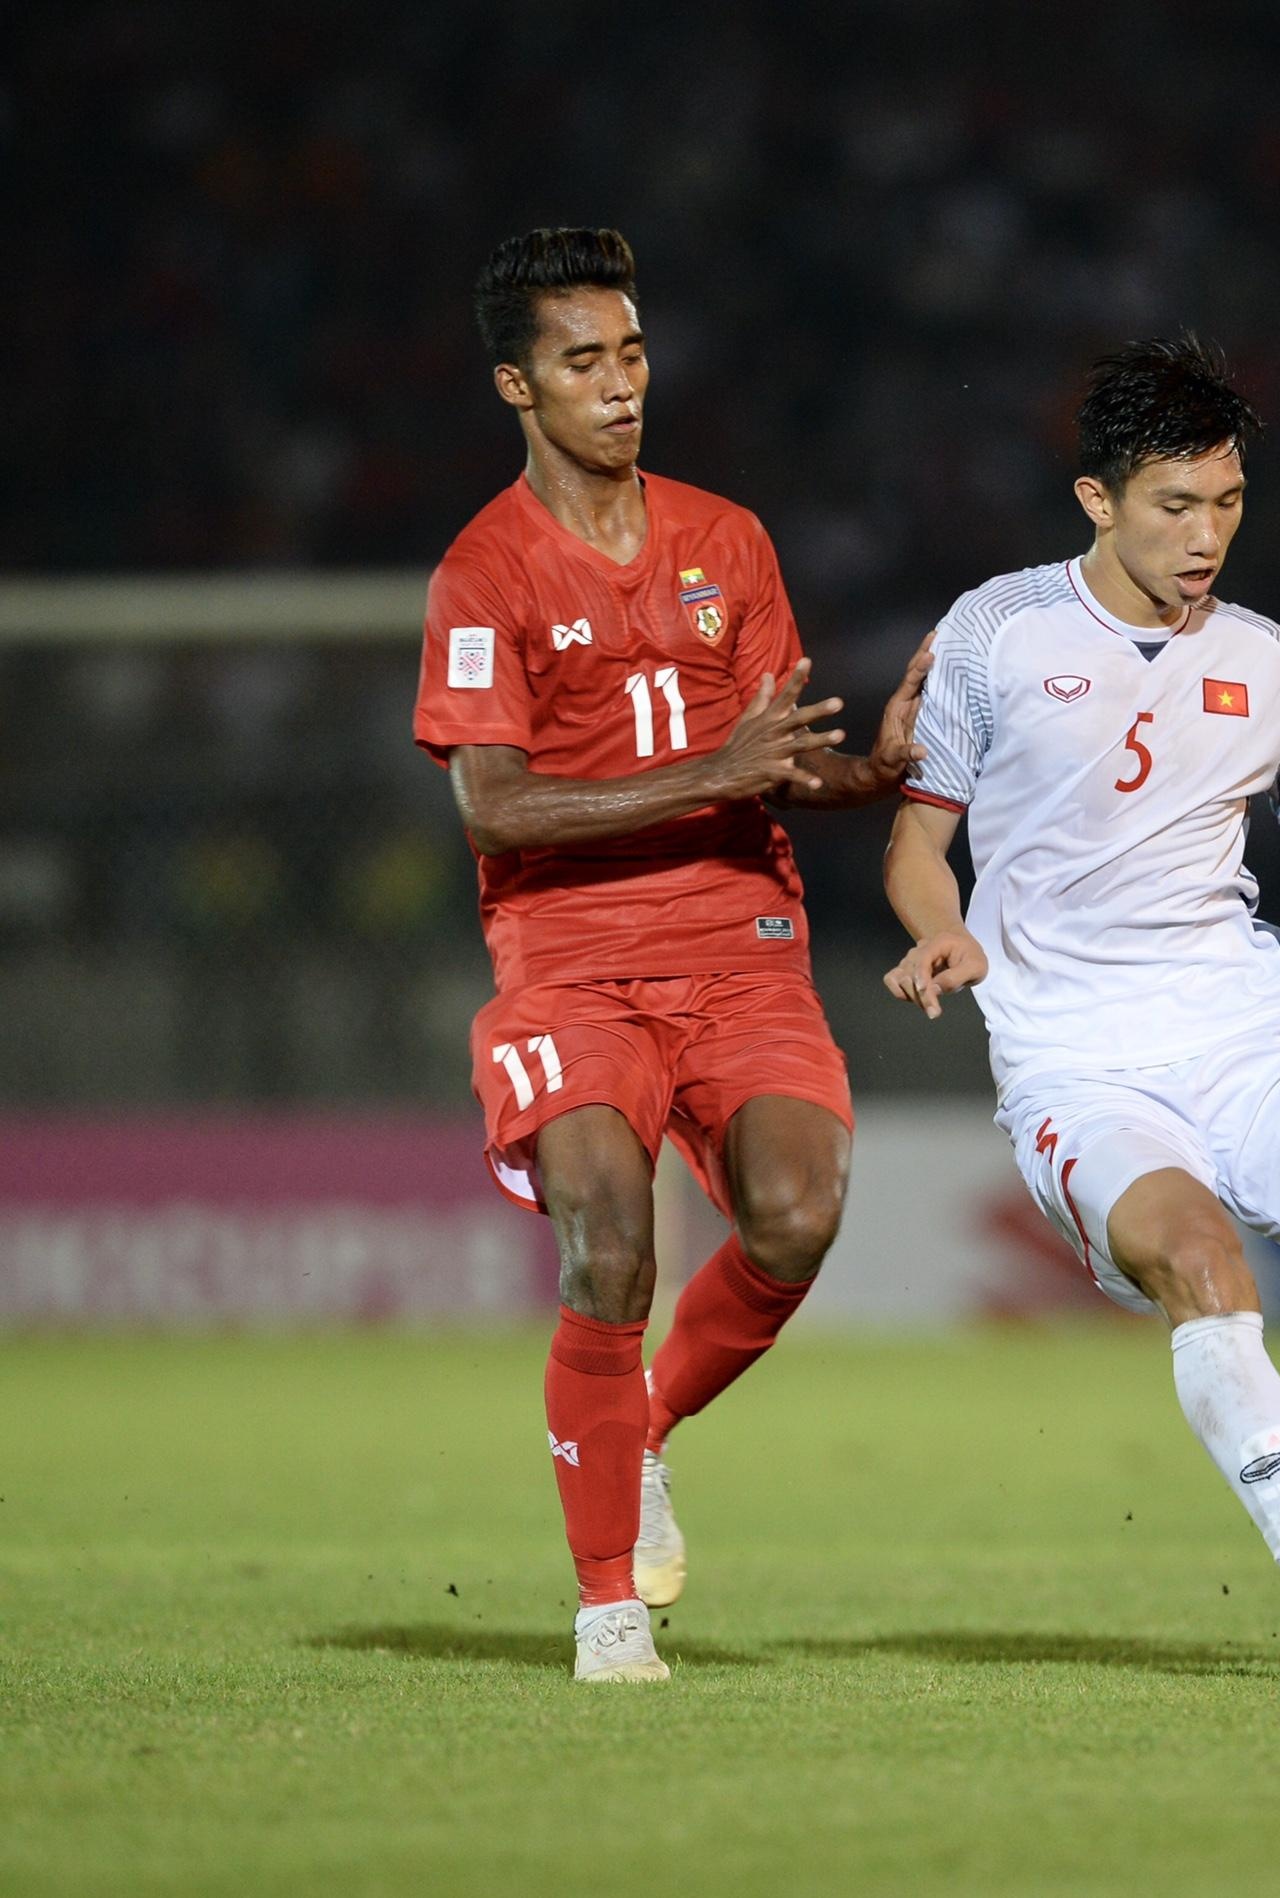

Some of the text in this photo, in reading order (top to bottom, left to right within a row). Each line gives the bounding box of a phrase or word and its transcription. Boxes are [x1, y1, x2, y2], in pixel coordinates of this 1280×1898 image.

[624, 667, 688, 758] 11
[1115, 713, 1153, 792] 5
[493, 1034, 563, 1111] 11
